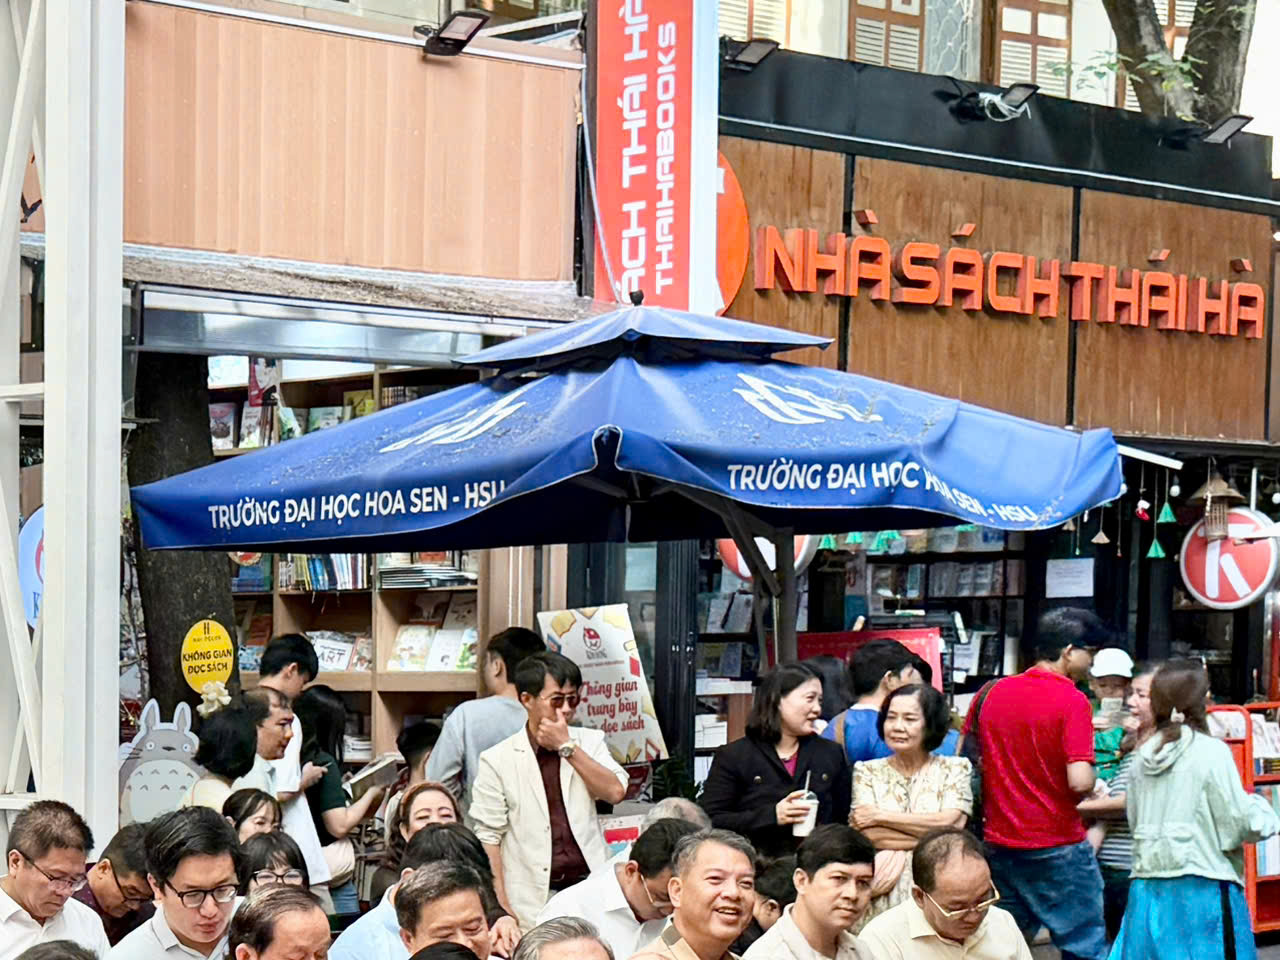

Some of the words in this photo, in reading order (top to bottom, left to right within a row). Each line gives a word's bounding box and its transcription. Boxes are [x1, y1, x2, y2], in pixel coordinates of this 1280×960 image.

[617, 73, 648, 189] THÁI
[655, 21, 677, 295] THAIHABOOKS
[615, 200, 646, 304] ÁCH
[755, 209, 891, 301] NHÀ
[892, 223, 1060, 318] SÁCH
[1062, 249, 1187, 331] THÁI
[1188, 258, 1265, 339] HÀ
[728, 457, 821, 491] TRƯỜNG
[826, 463, 866, 495] ĐẠI
[871, 461, 920, 493] HỌC
[208, 496, 280, 529] TRƯỜNG
[284, 497, 316, 529] ĐẠI
[321, 493, 360, 525] HỌC
[365, 489, 406, 517] HOA
[410, 485, 447, 513] SEN
[183, 650, 211, 662] KHÔNG
[213, 649, 232, 659] GIAN
[207, 661, 228, 672] SÁCH
[615, 677, 638, 697] gian
